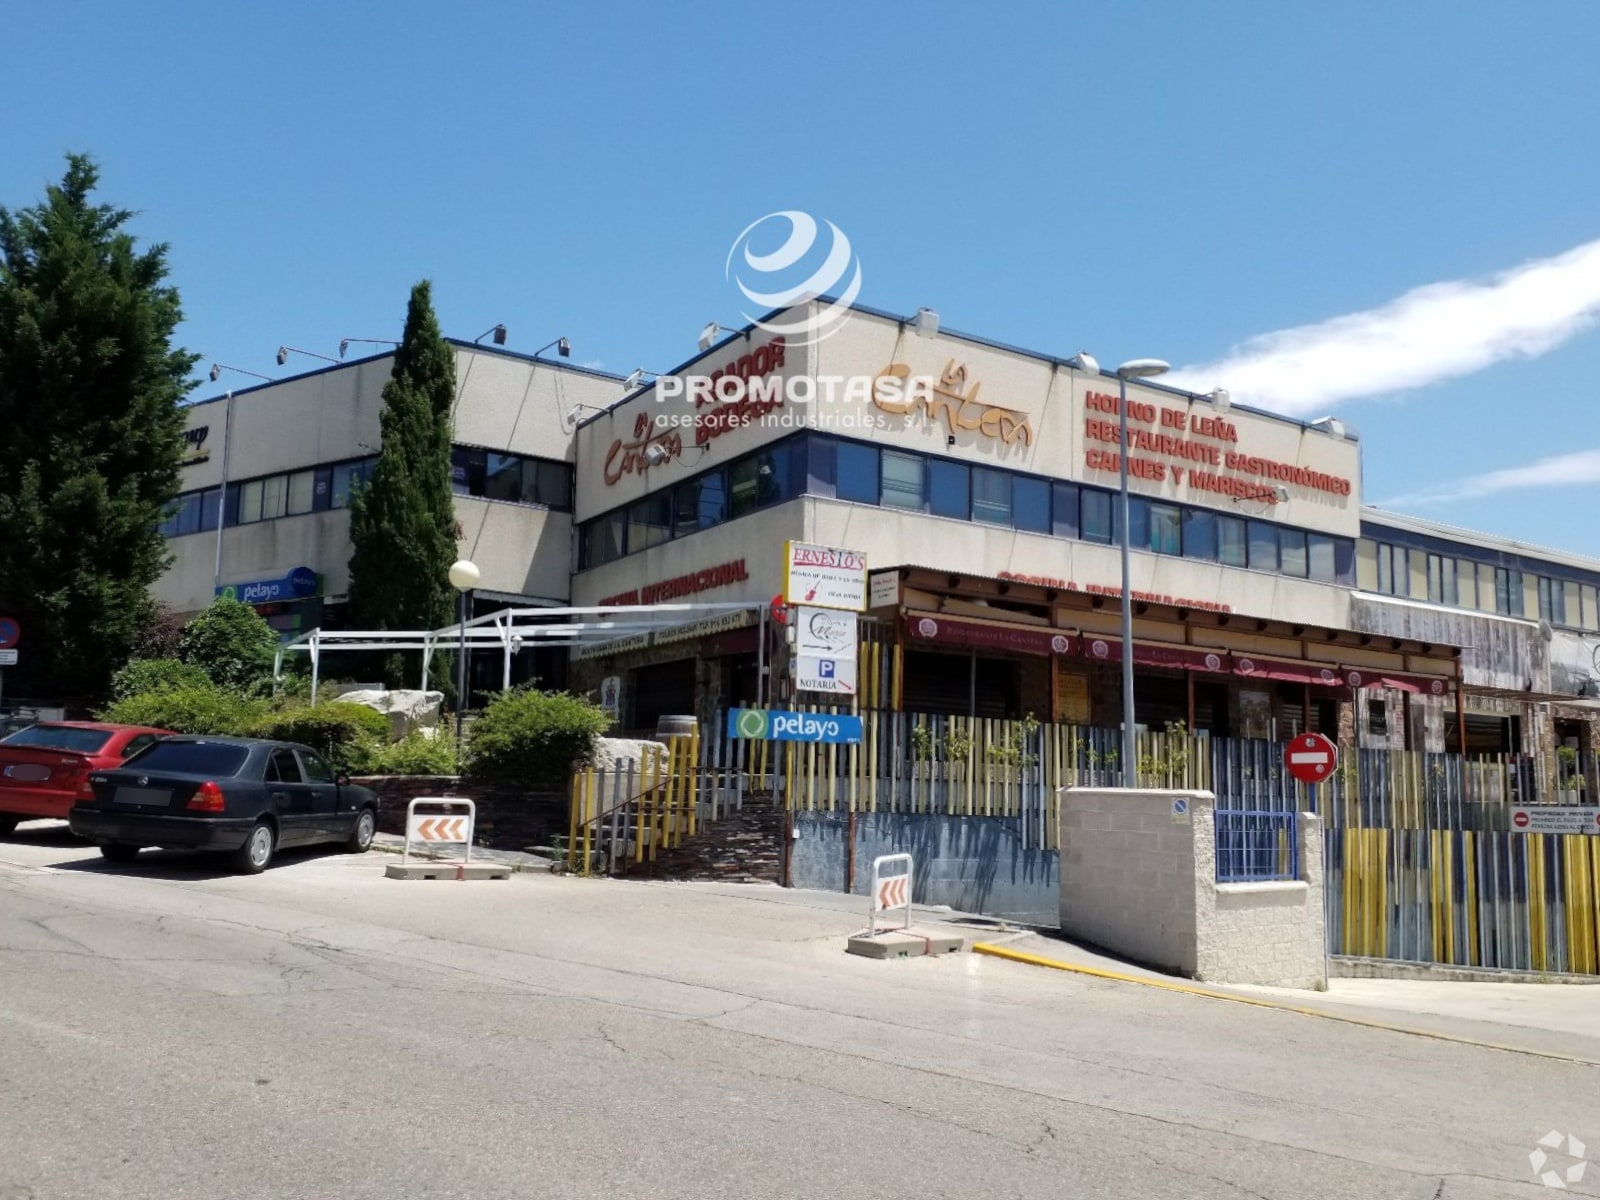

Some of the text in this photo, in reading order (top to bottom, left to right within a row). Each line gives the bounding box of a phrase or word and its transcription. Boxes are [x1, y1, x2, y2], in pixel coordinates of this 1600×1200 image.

[1161, 407, 1186, 431] DE
[1191, 415, 1239, 443] LEÑA
[1085, 418, 1352, 497] RESTAURANTE GASTRONÓMICO
[1171, 464, 1185, 486] Y
[1188, 469, 1279, 505] MARISCOS
[244, 583, 280, 602] pelayo
[641, 558, 749, 606] INTERNACIONAL
[799, 679, 837, 690] NOTARIA
[773, 713, 839, 741] pelayo
